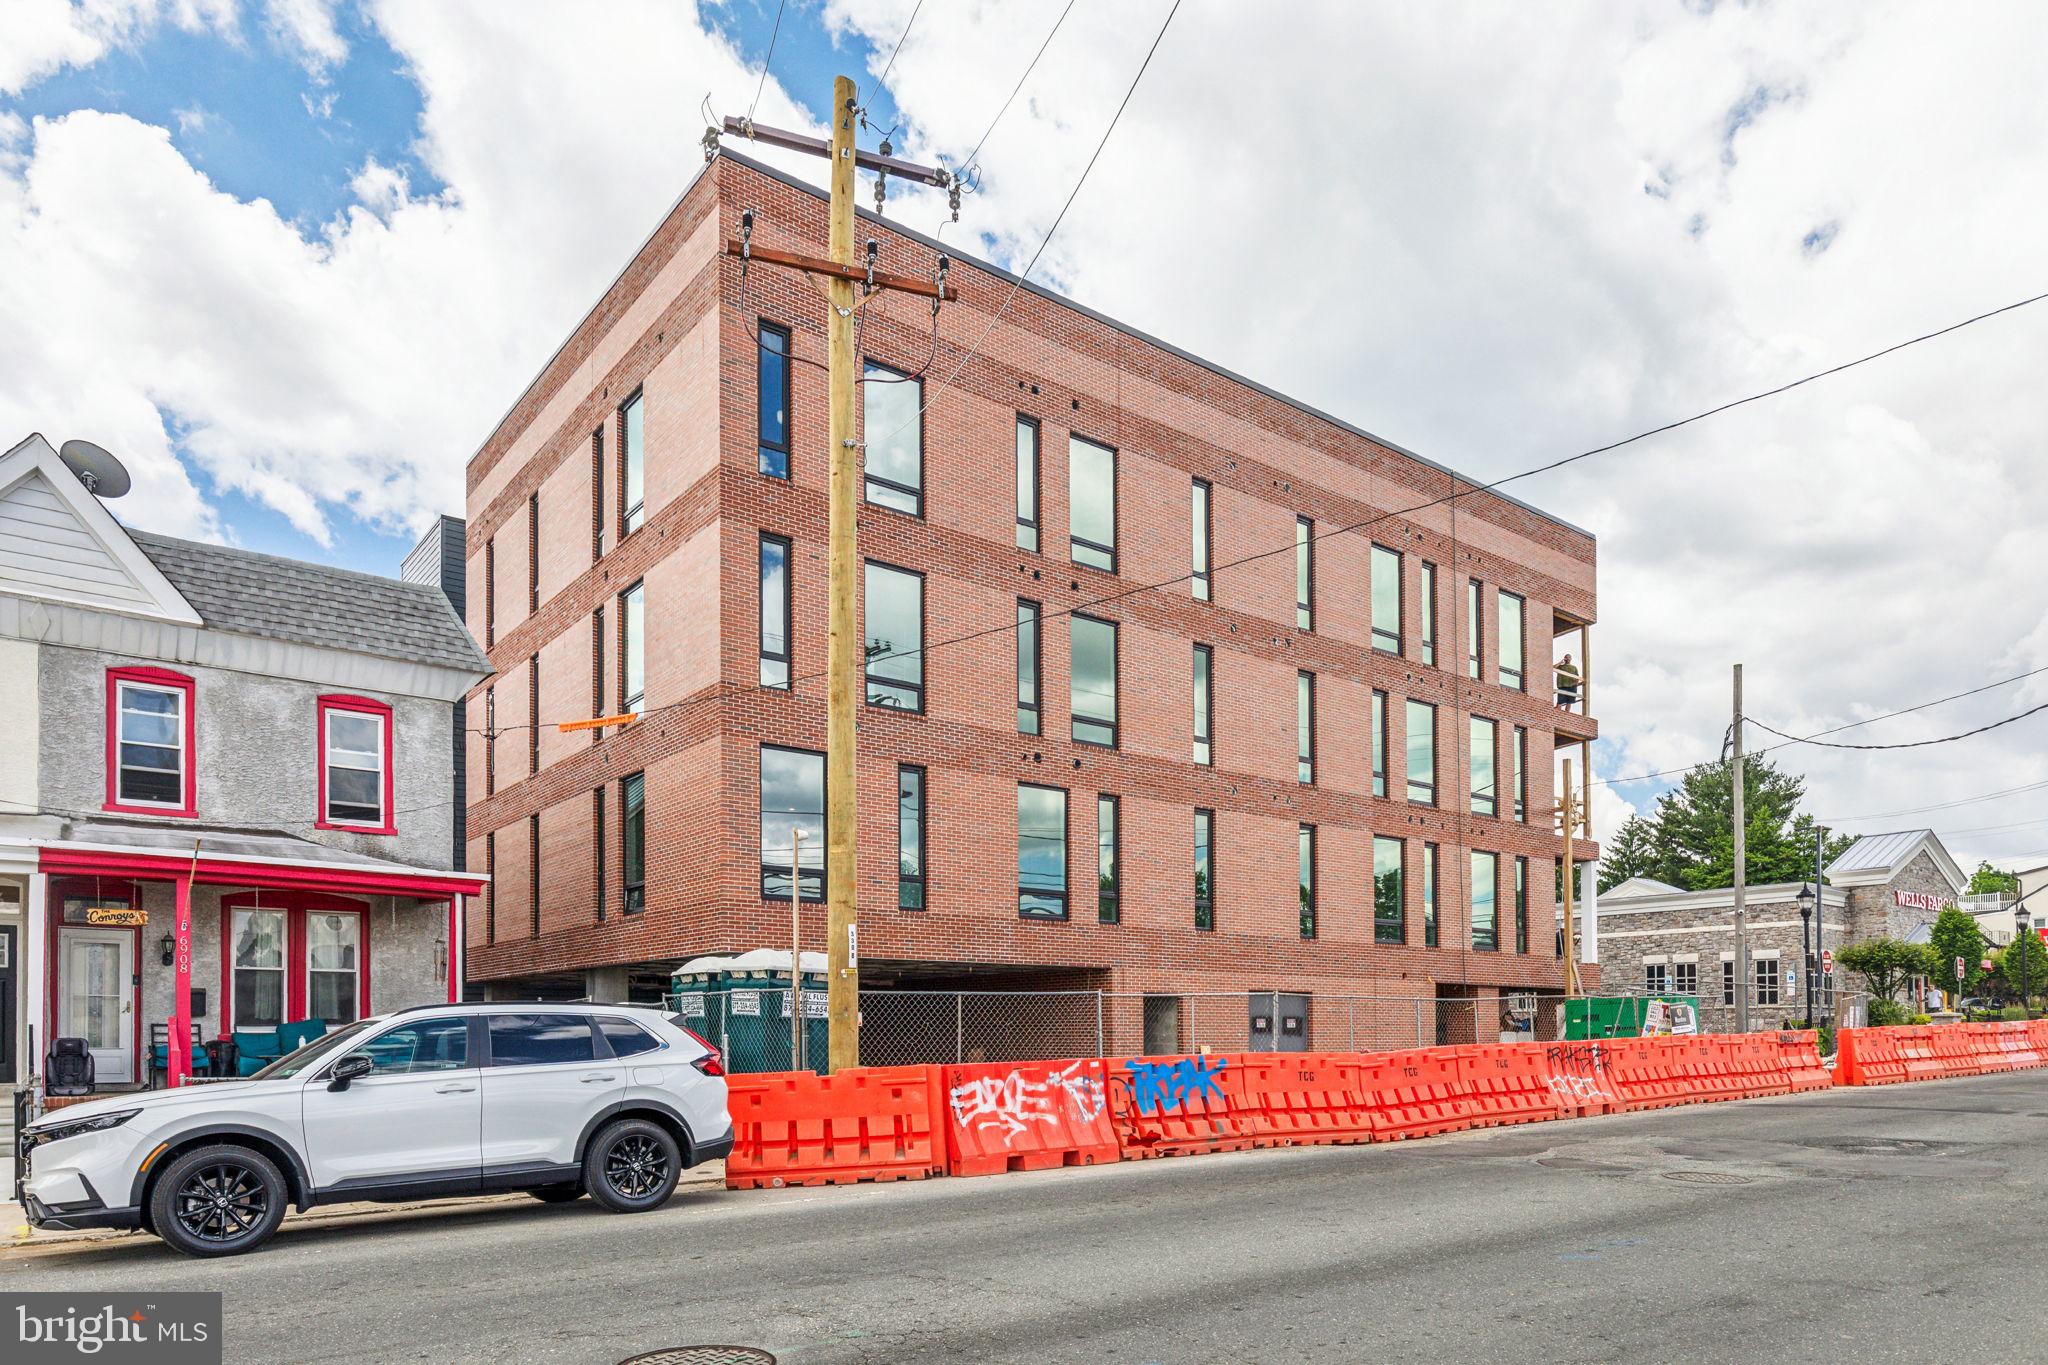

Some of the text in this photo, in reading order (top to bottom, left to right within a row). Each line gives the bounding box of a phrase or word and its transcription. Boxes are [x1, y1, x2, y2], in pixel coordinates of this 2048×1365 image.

[1896, 889, 1926, 909] WELLS
[89, 910, 135, 923] Conroys
[180, 936, 188, 973] 6908
[1298, 1071, 1315, 1082] TCG
[1403, 1067, 1418, 1077] TCG
